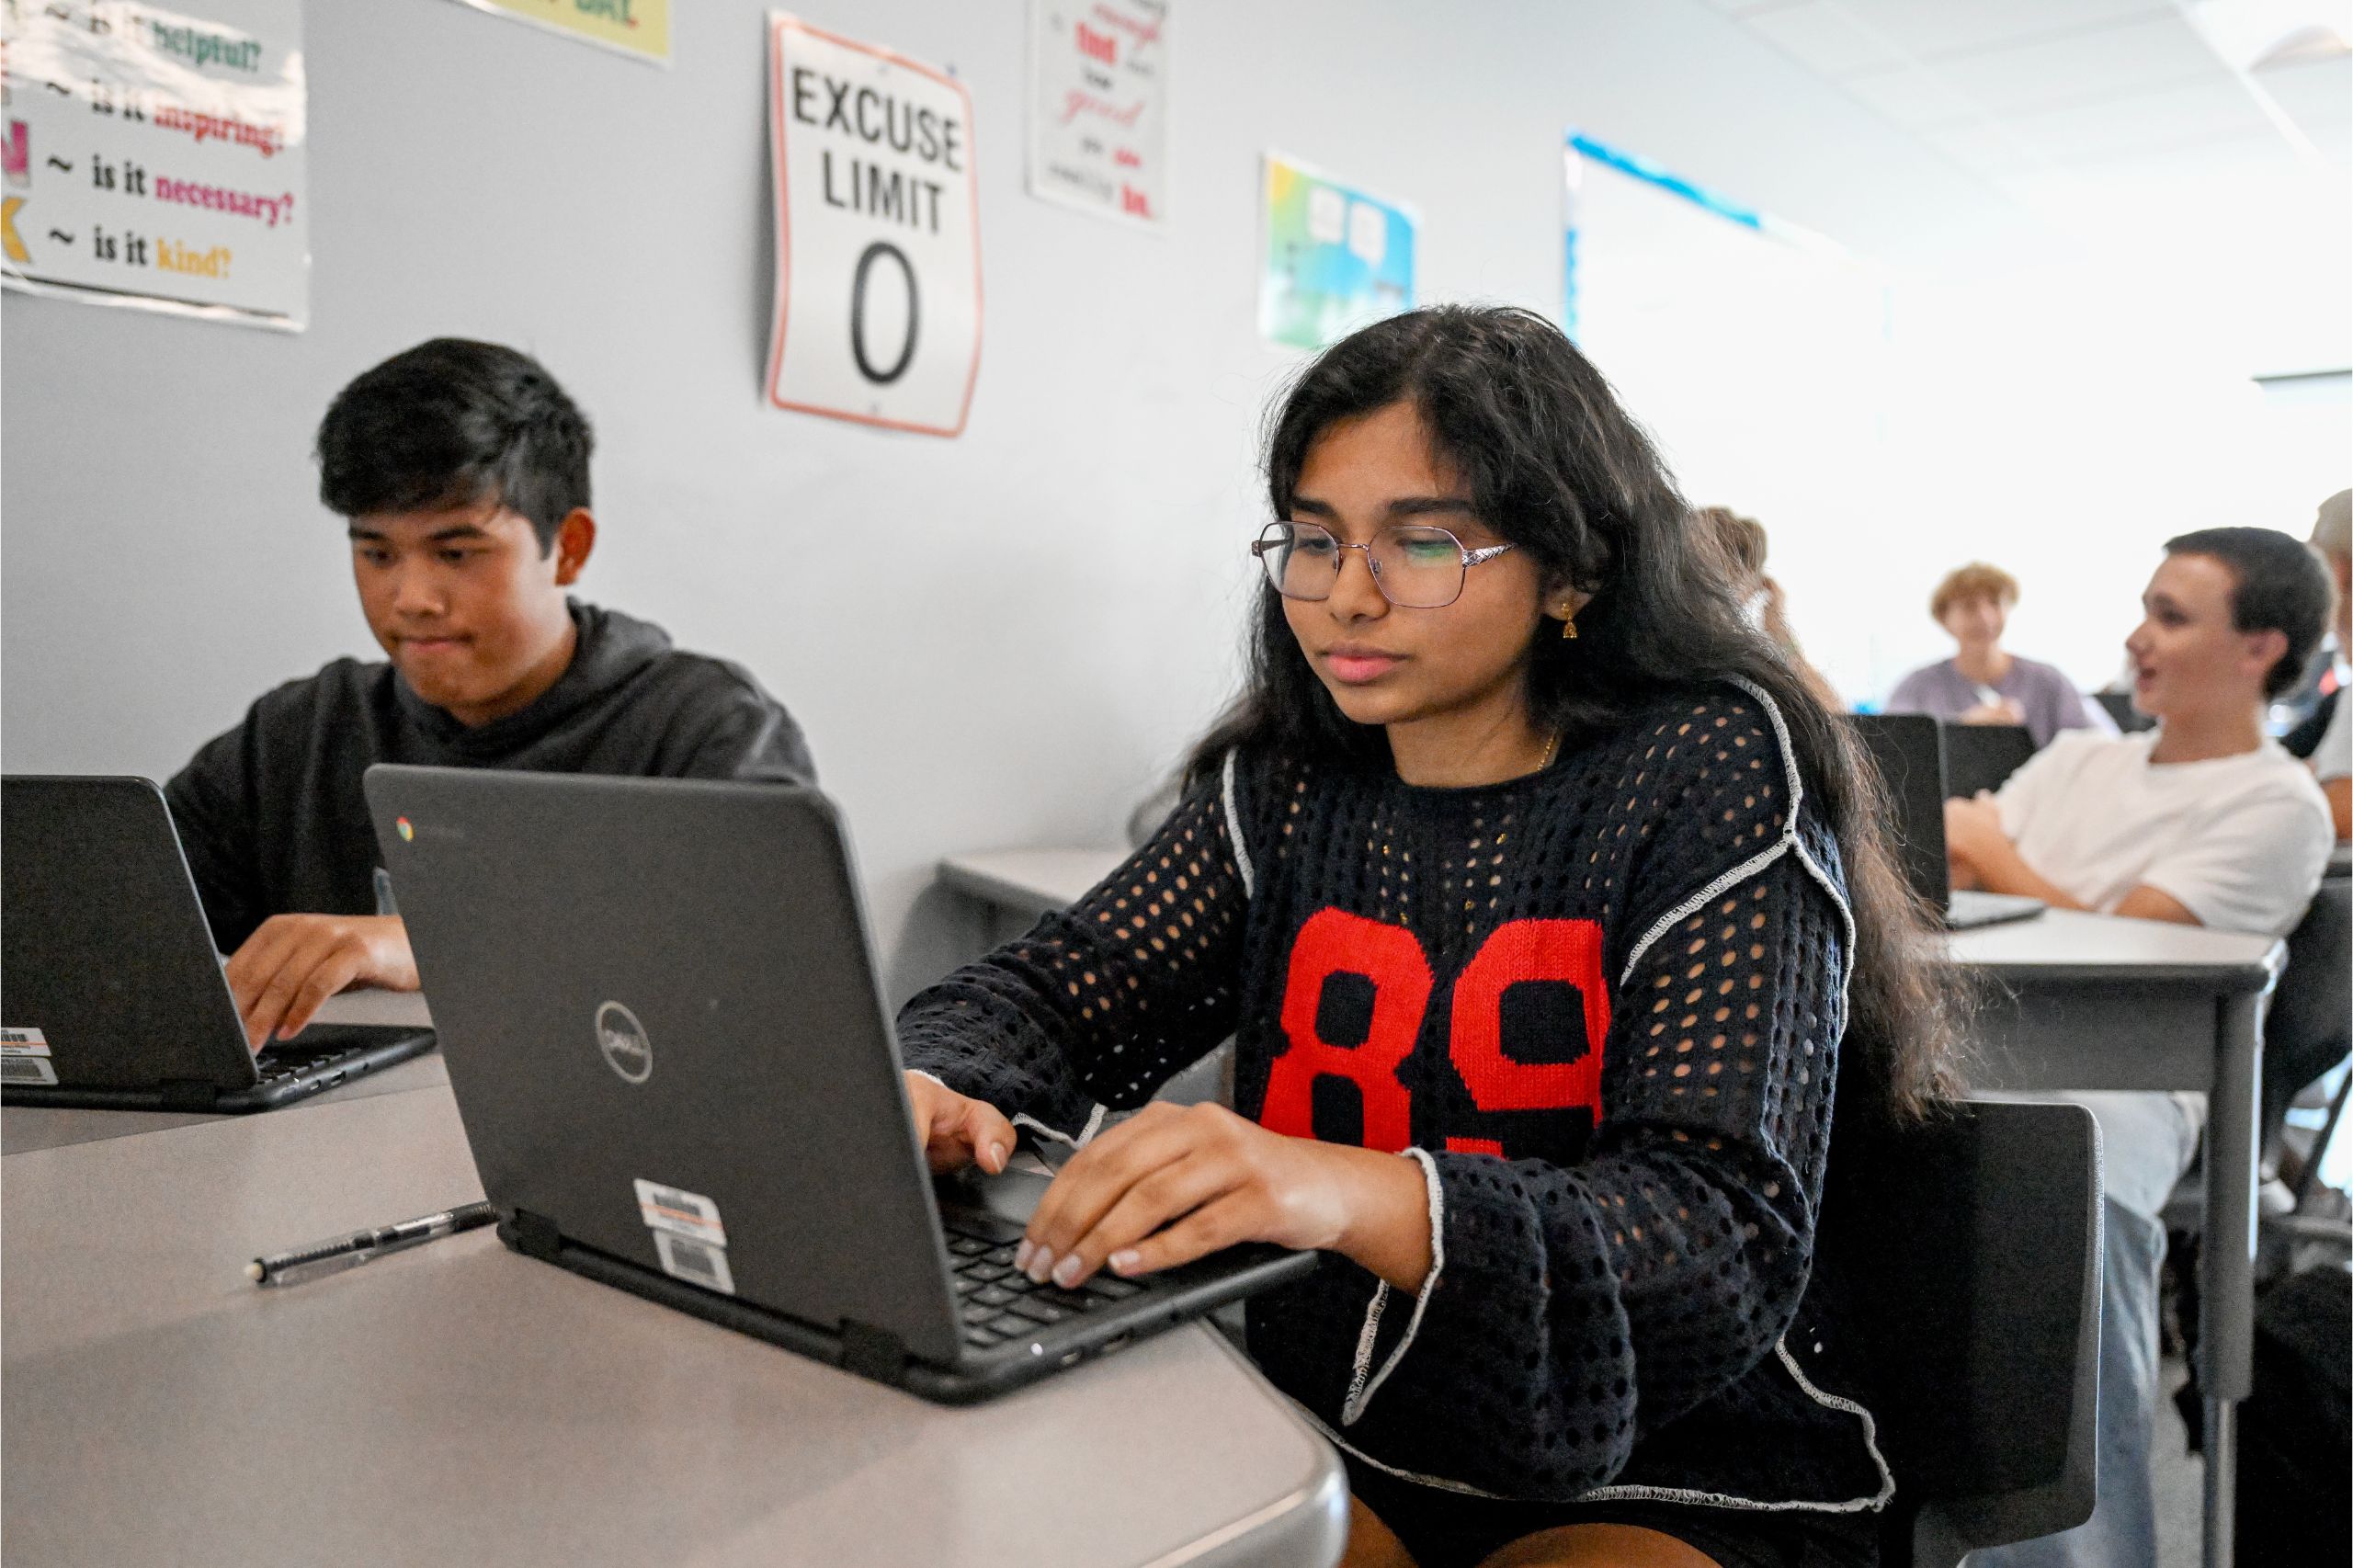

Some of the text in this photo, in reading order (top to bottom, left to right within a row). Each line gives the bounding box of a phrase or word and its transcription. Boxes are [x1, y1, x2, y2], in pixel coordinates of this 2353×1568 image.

[790, 66, 963, 172] EXCUSE
[93, 153, 116, 190] is
[124, 160, 146, 197] it
[154, 176, 294, 228] necessary?
[822, 150, 946, 234] LIMIT
[94, 225, 117, 262] is
[126, 231, 147, 267] it
[155, 237, 233, 278] kind?
[1260, 905, 1611, 1161] 89
